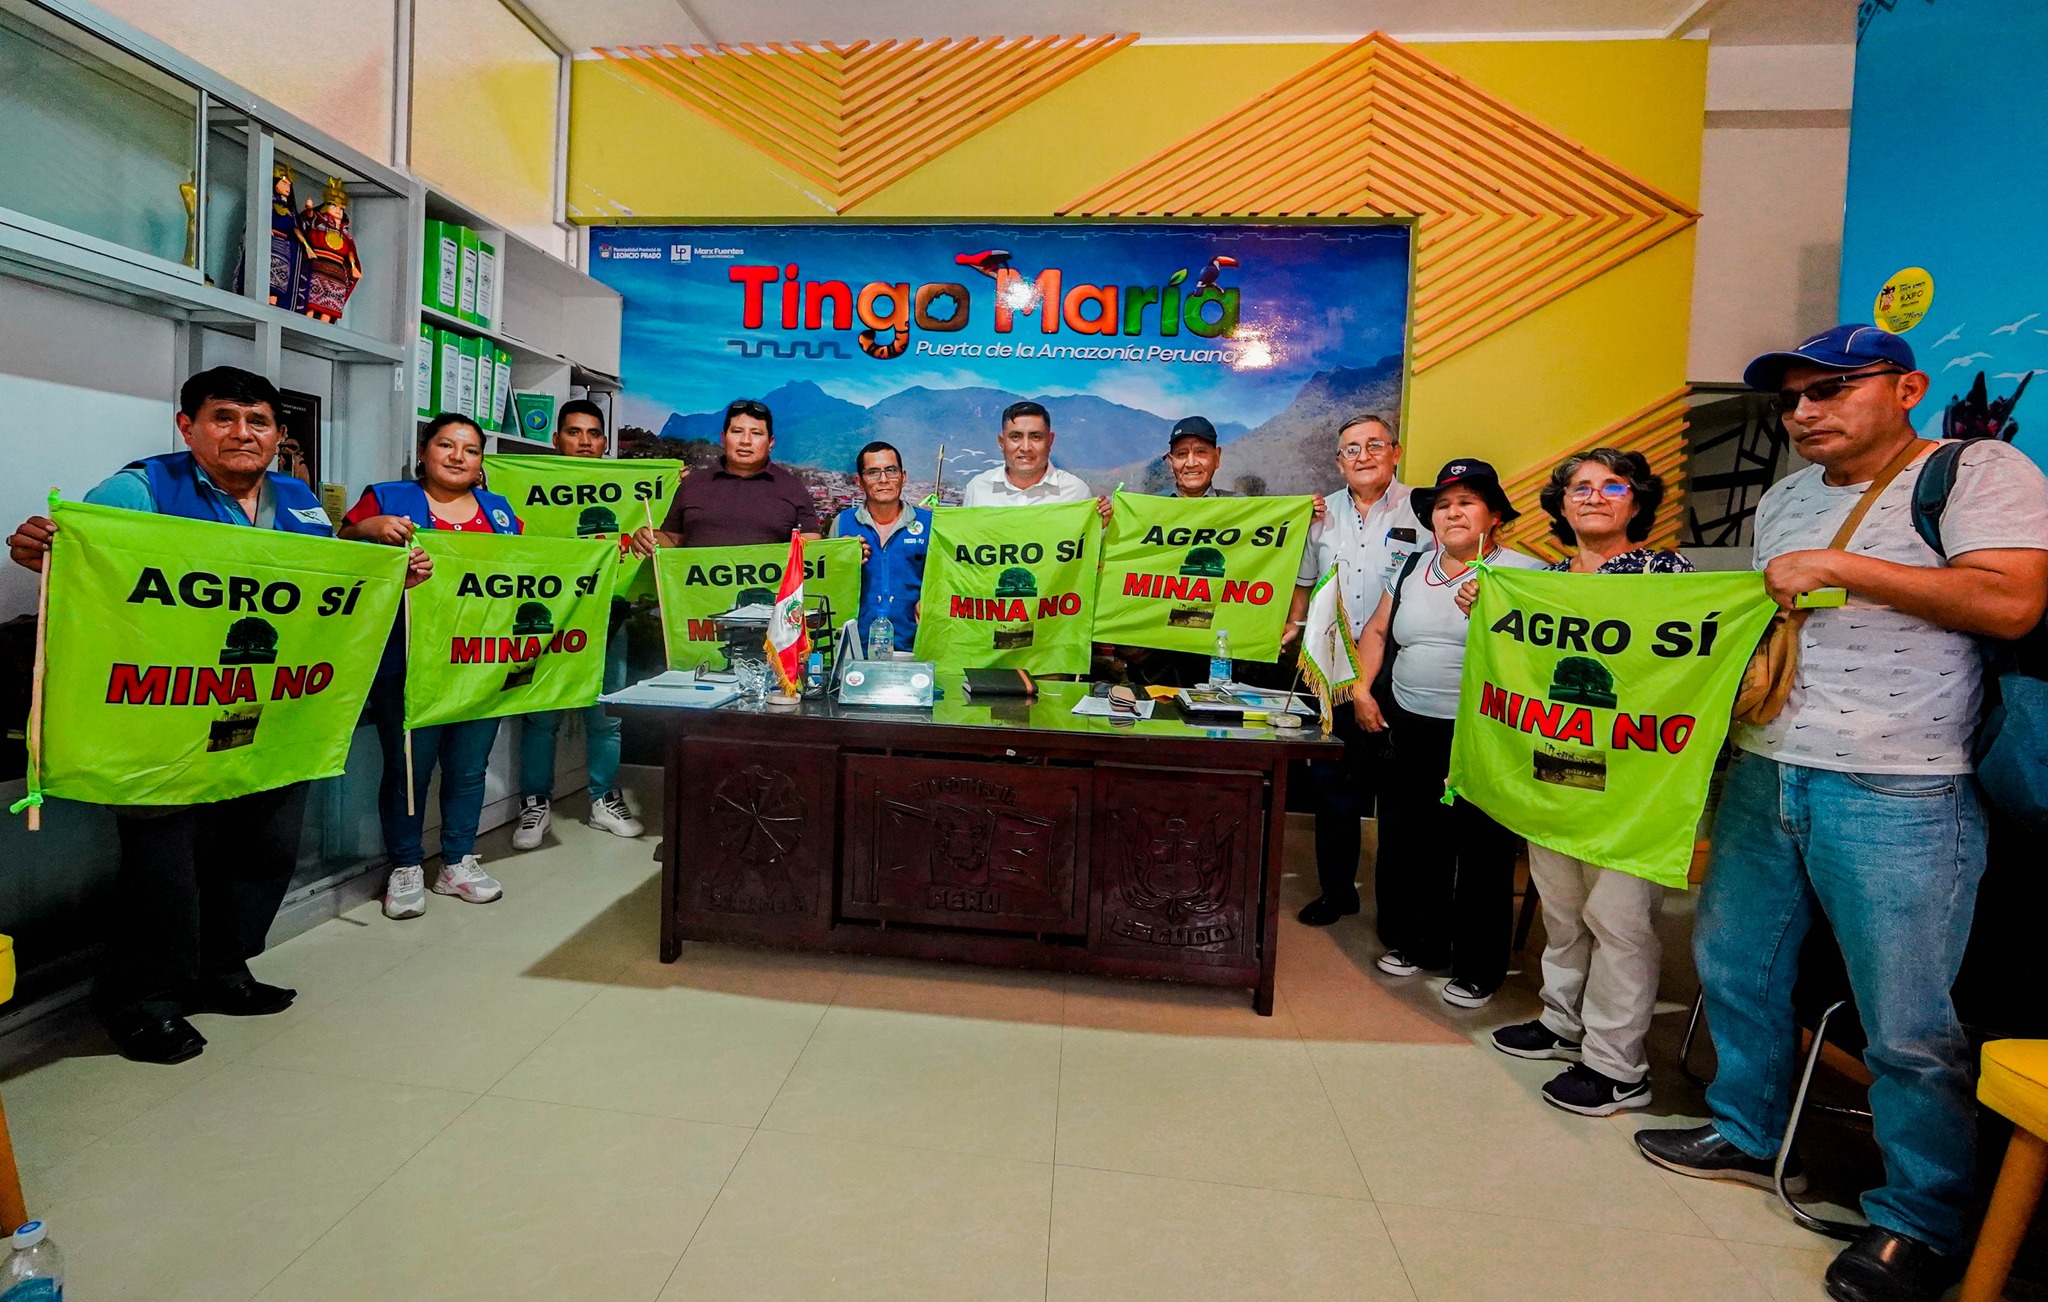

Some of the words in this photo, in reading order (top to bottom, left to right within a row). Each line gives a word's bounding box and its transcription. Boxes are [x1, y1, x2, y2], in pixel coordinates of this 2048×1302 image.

[728, 263, 971, 360] Tingo
[994, 265, 1241, 338] María
[915, 341, 981, 358] Puerta
[985, 342, 1012, 358] de
[1016, 343, 1033, 358] la
[1037, 344, 1143, 361] Amazonía
[1146, 346, 1240, 363] Peruana
[525, 483, 622, 506] AGRO
[633, 476, 663, 501] SÍ
[955, 543, 1044, 566] AGRO
[1056, 533, 1085, 563] SÍ
[1141, 525, 1241, 547] AGRO
[1251, 521, 1290, 548] SÍ
[126, 566, 301, 615] AGRO
[317, 580, 366, 616] SÍ
[456, 572, 562, 598] AGRO
[574, 568, 601, 598] SÍ
[685, 563, 782, 586] AGRO
[1122, 572, 1211, 602] MINA
[1220, 580, 1274, 605] NO
[950, 594, 1029, 622] MINA
[1037, 592, 1082, 620] NO
[450, 636, 541, 664] MINA
[541, 629, 587, 655] NO
[1490, 609, 1632, 655] AGRO
[1651, 611, 1722, 658] SÍ
[105, 662, 257, 706] MINA
[270, 661, 334, 701] NO
[1480, 681, 1593, 747] MINA
[1612, 713, 1696, 754] NO
